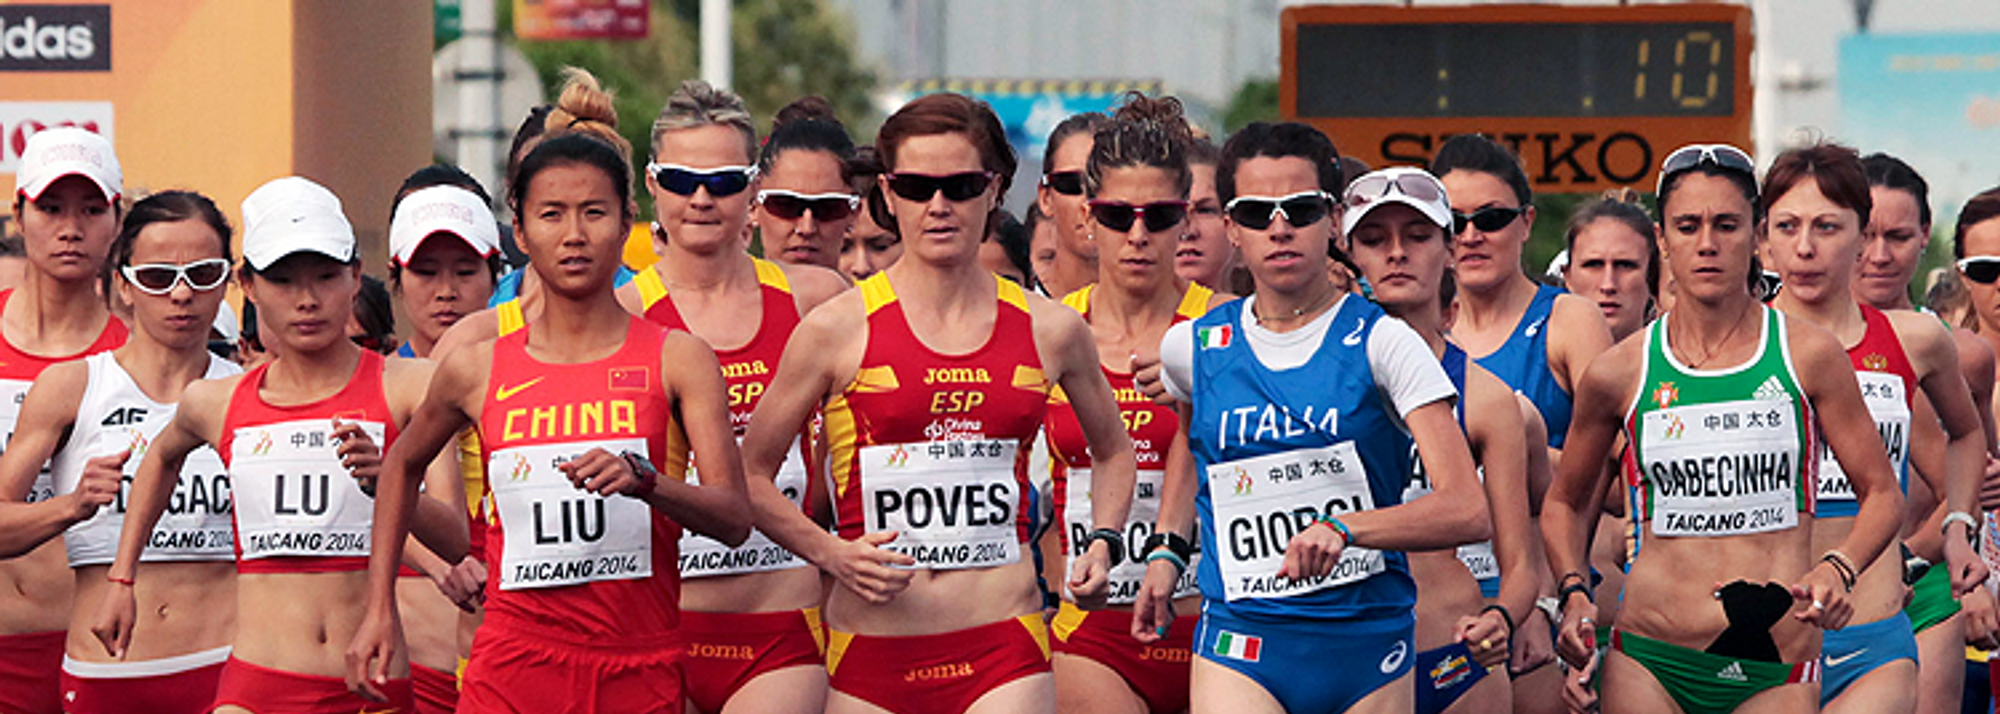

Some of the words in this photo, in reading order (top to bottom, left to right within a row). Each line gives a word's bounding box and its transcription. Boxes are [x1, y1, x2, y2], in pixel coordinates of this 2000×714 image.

[1381, 131, 1653, 184] SKO
[923, 367, 991, 384] Joma
[728, 382, 764, 406] SP
[930, 391, 985, 414] ESP
[503, 400, 636, 441] CHINA
[1119, 410, 1153, 431] SP
[1219, 402, 1338, 450] ITALIA
[1652, 451, 1791, 498] CABECINHA
[275, 474, 329, 516] LU
[874, 482, 1011, 530] POVES
[533, 498, 606, 545] LIU
[1666, 512, 1746, 531] TAICANG
[1748, 507, 1784, 529] 2014
[250, 532, 323, 551] TAICANG
[325, 532, 365, 551] 2014
[972, 542, 1007, 563] 2014
[514, 559, 594, 583] TAICANG
[597, 555, 638, 576] 2014
[678, 552, 758, 573] TAICANG
[1330, 556, 1370, 580] 2014
[1138, 645, 1191, 662] Jom
